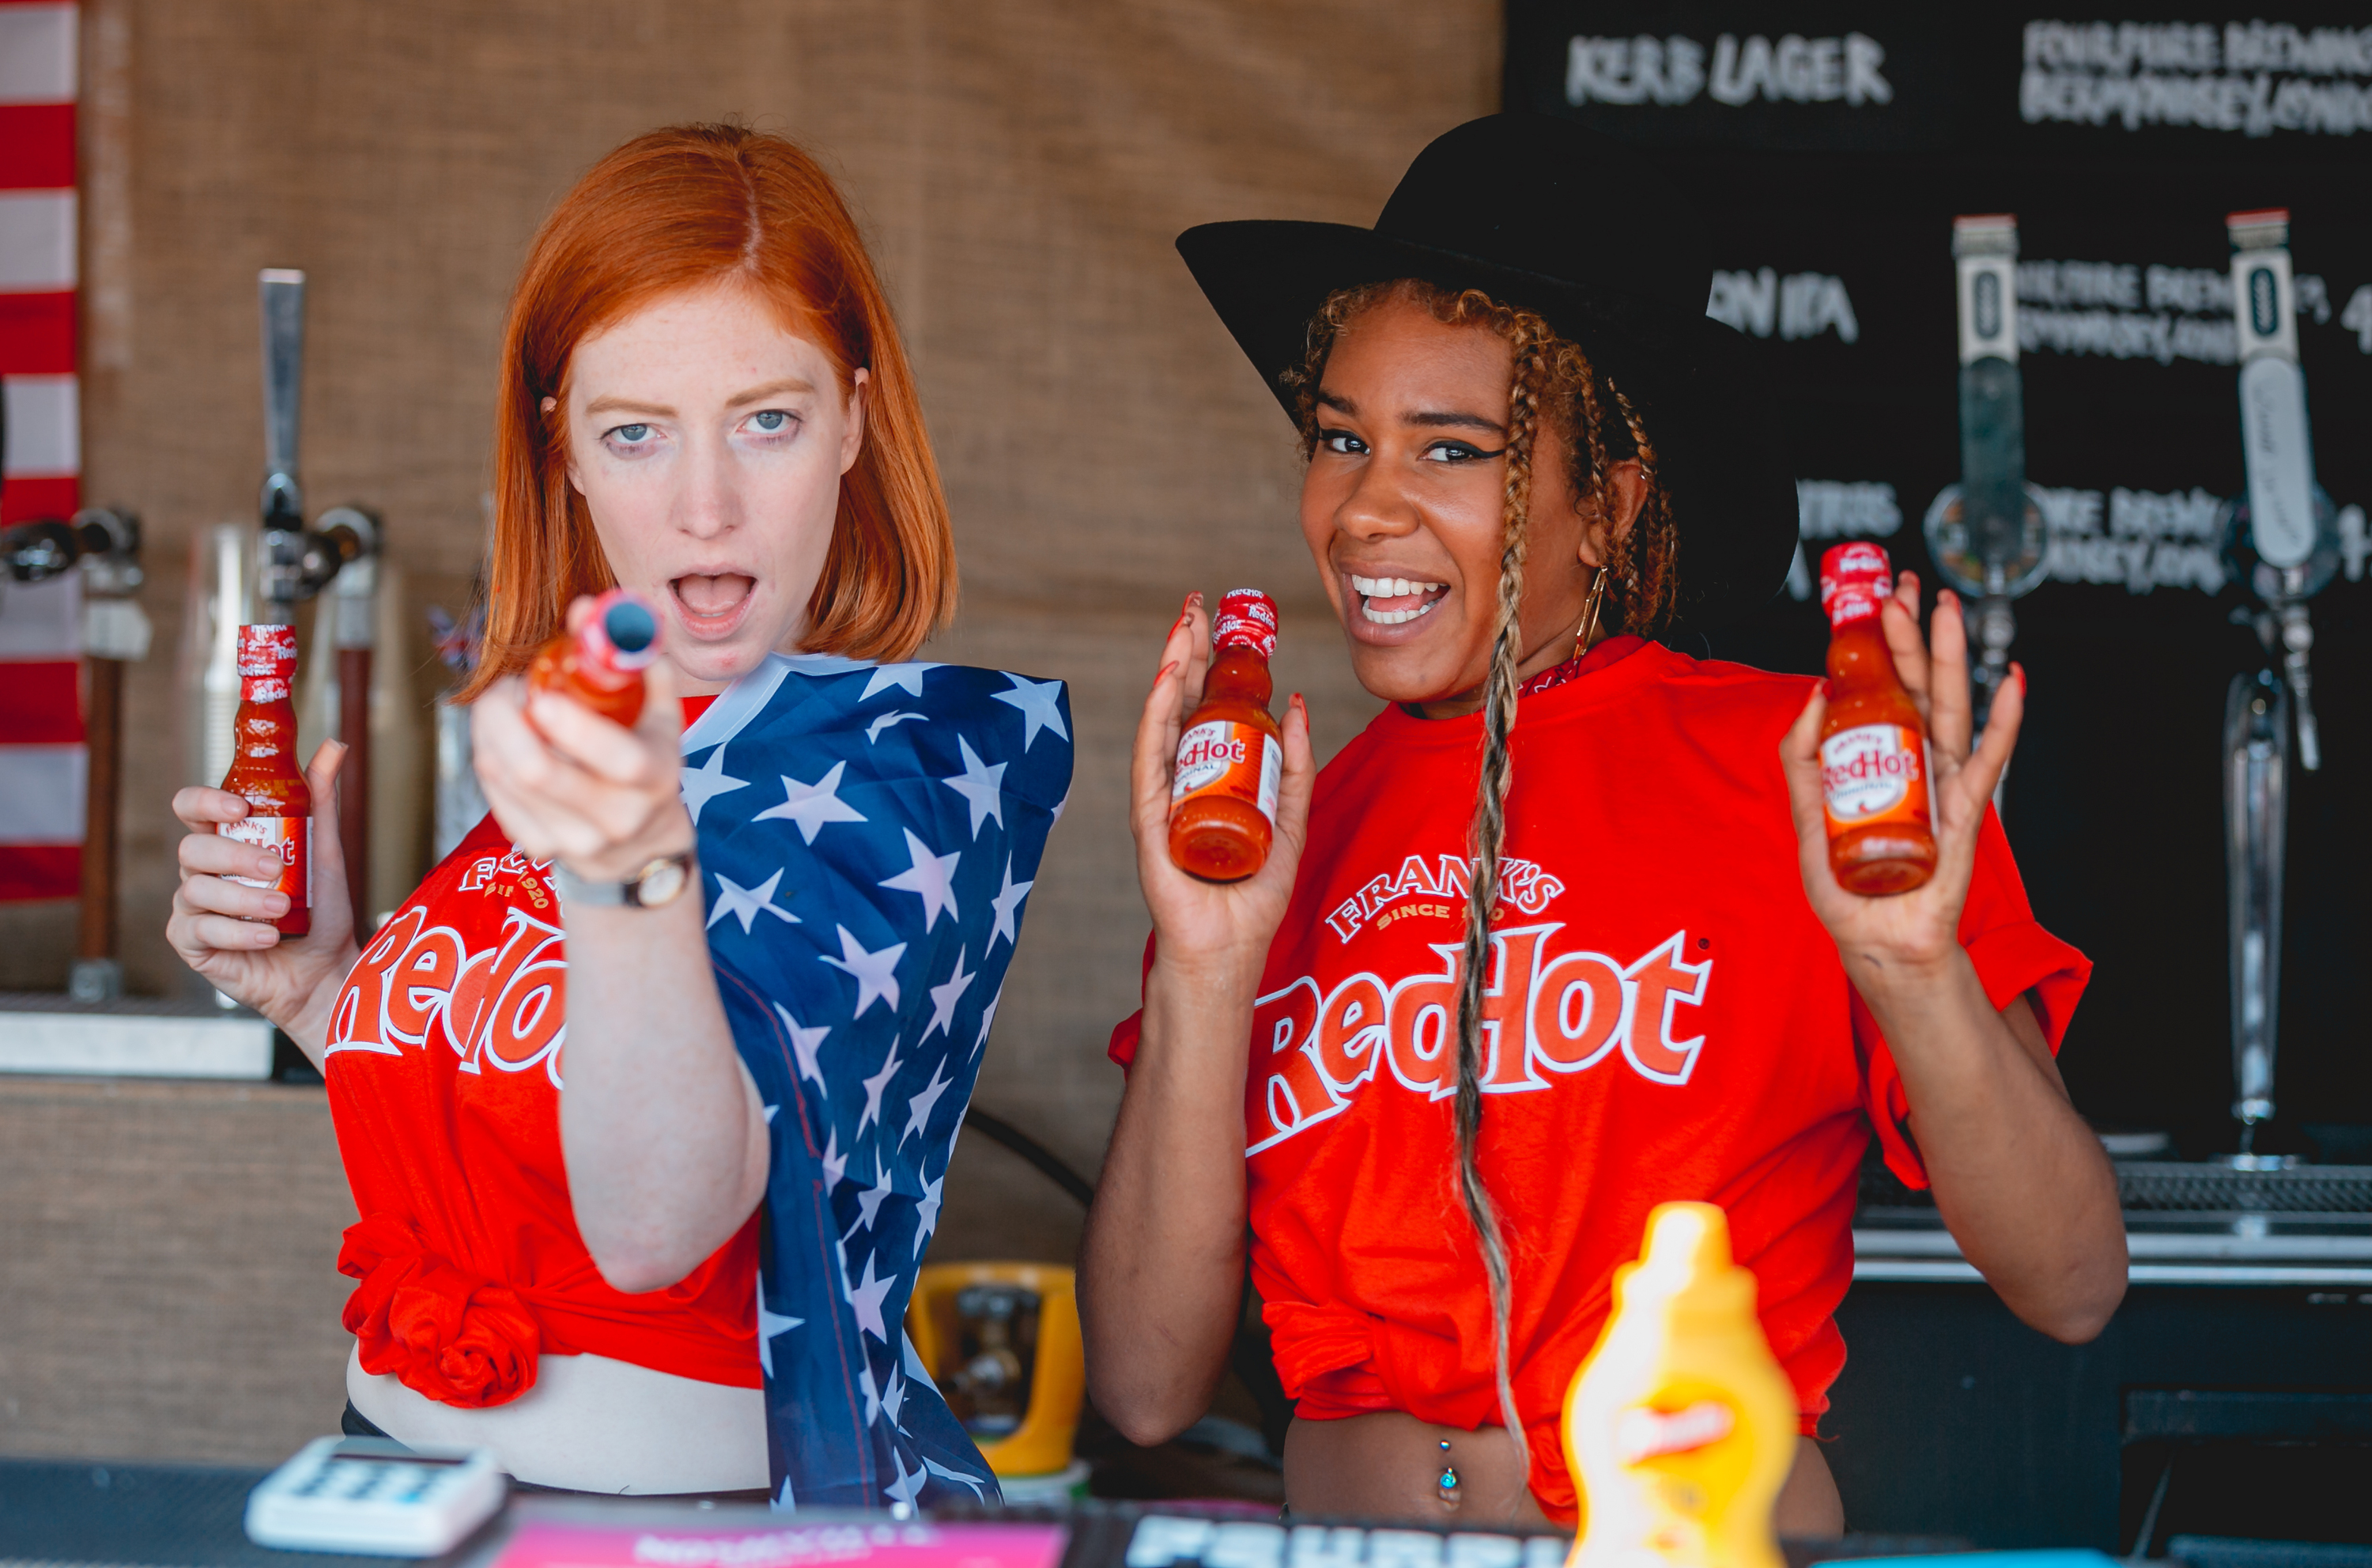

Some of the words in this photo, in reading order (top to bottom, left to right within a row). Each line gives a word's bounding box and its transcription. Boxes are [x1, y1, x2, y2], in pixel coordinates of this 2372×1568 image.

[1566, 33, 1705, 106] KERB
[1708, 32, 1894, 108] LAGER
[1779, 270, 1860, 346] IPA
[1248, 605, 1275, 631] RedHot
[1325, 854, 1566, 944] FRANK'S
[1377, 904, 1450, 931] SINCE
[1245, 922, 1713, 1158] RedHot
